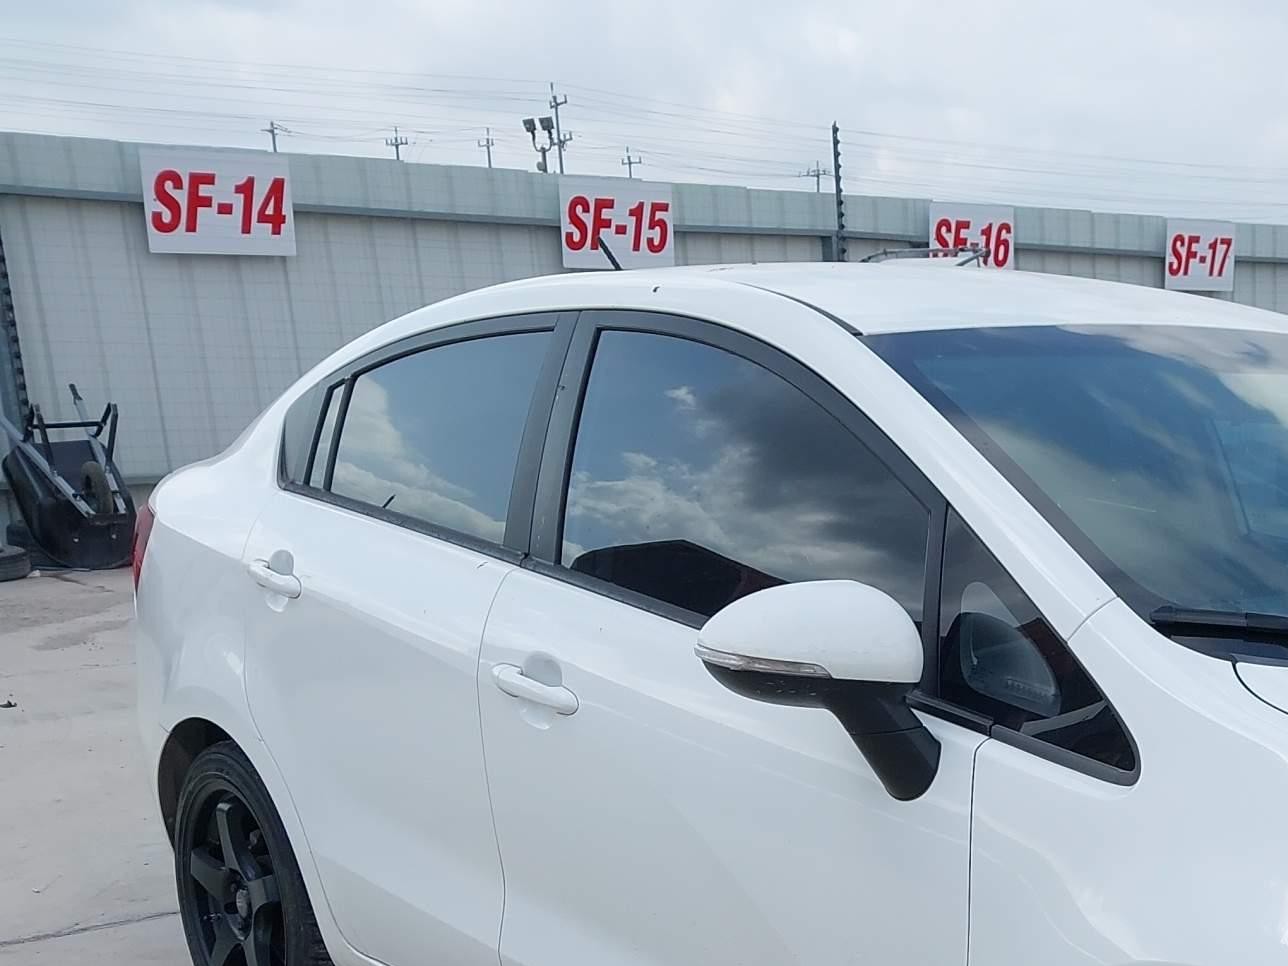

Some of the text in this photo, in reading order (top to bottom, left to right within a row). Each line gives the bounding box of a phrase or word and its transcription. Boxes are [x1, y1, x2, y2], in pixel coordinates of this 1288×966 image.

[151, 169, 287, 236] SF-14
[564, 195, 670, 254] SF-15
[934, 218, 1012, 268] SF-16
[1168, 234, 1233, 277] SF-17
